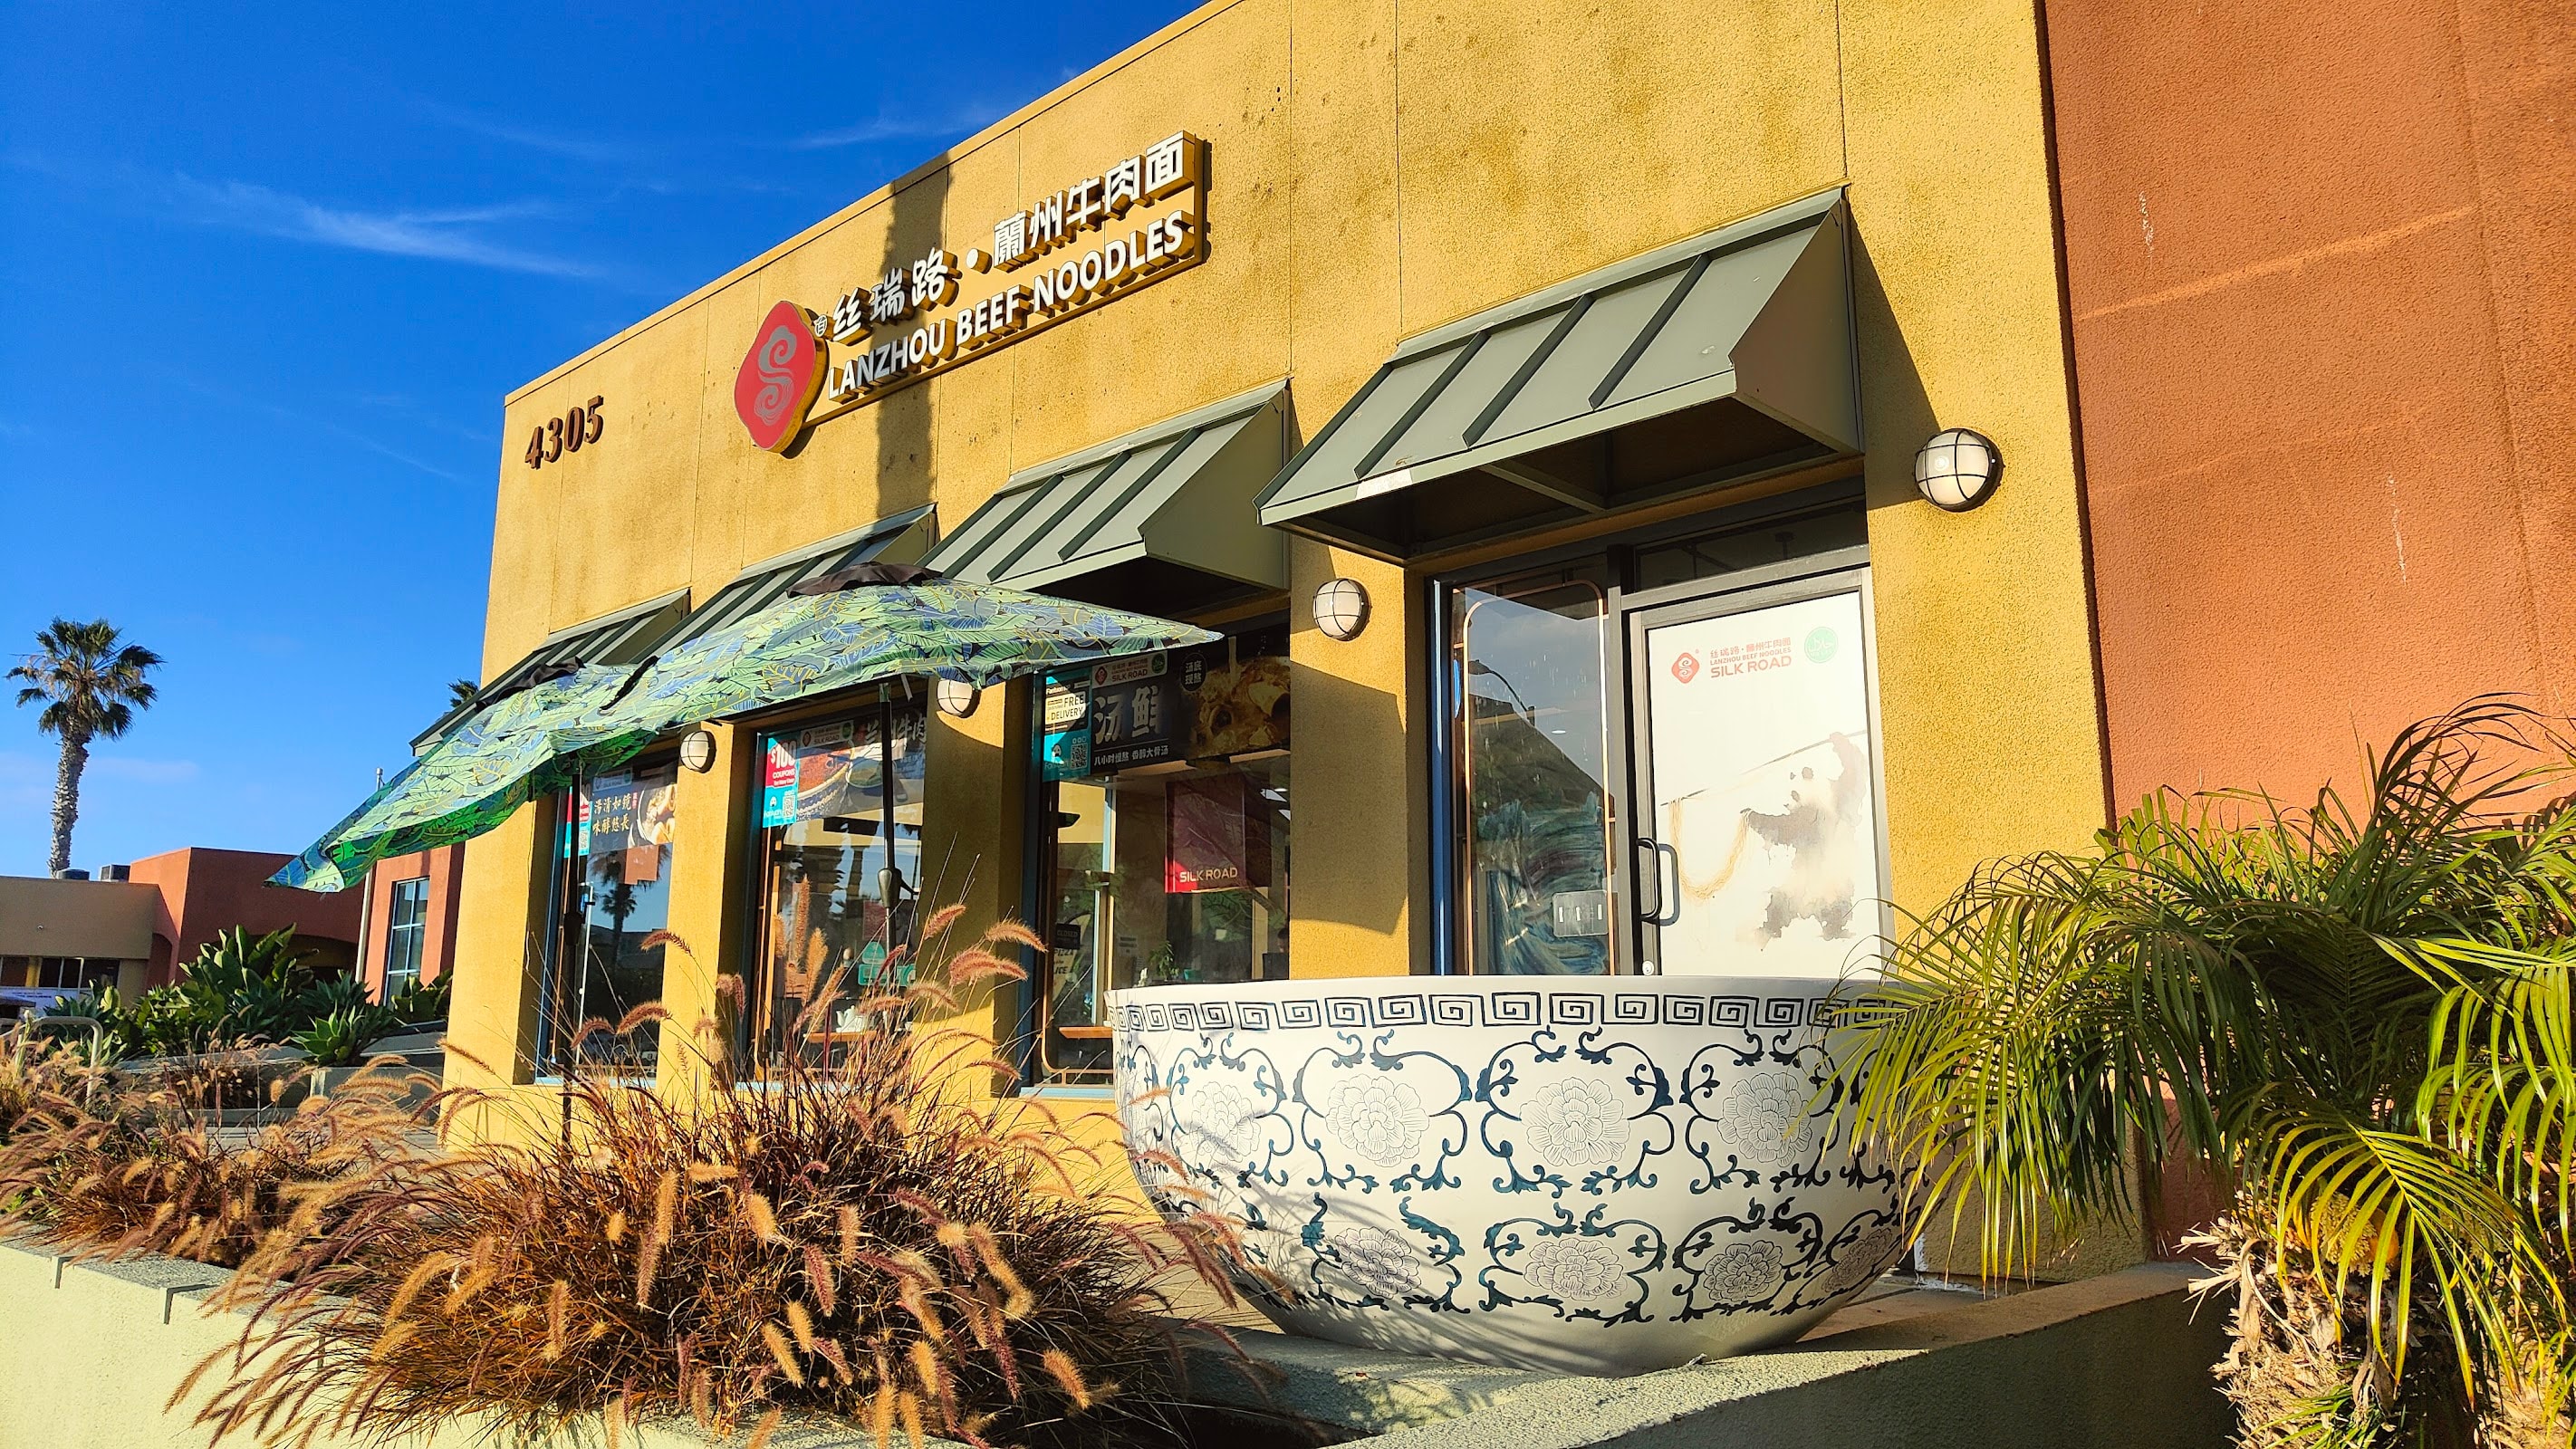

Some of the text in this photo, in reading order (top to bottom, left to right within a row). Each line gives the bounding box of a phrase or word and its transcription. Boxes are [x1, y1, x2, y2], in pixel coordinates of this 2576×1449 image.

[829, 209, 1184, 400] LANZHOU BEEF NOODLES
[524, 395, 604, 470] 4305
[1710, 647, 1792, 666] LANZHOU BEEF NOODLES
[1111, 668, 1148, 682] SILK ROAD
[1710, 655, 1792, 678] SILK ROAD
[1063, 694, 1084, 707] FREE
[1051, 706, 1083, 721] DELIVERY
[865, 713, 927, 744] 兰牛肉
[771, 740, 797, 769] $100
[773, 768, 795, 779] COUPONS
[1179, 867, 1238, 883] SILK ROAD
